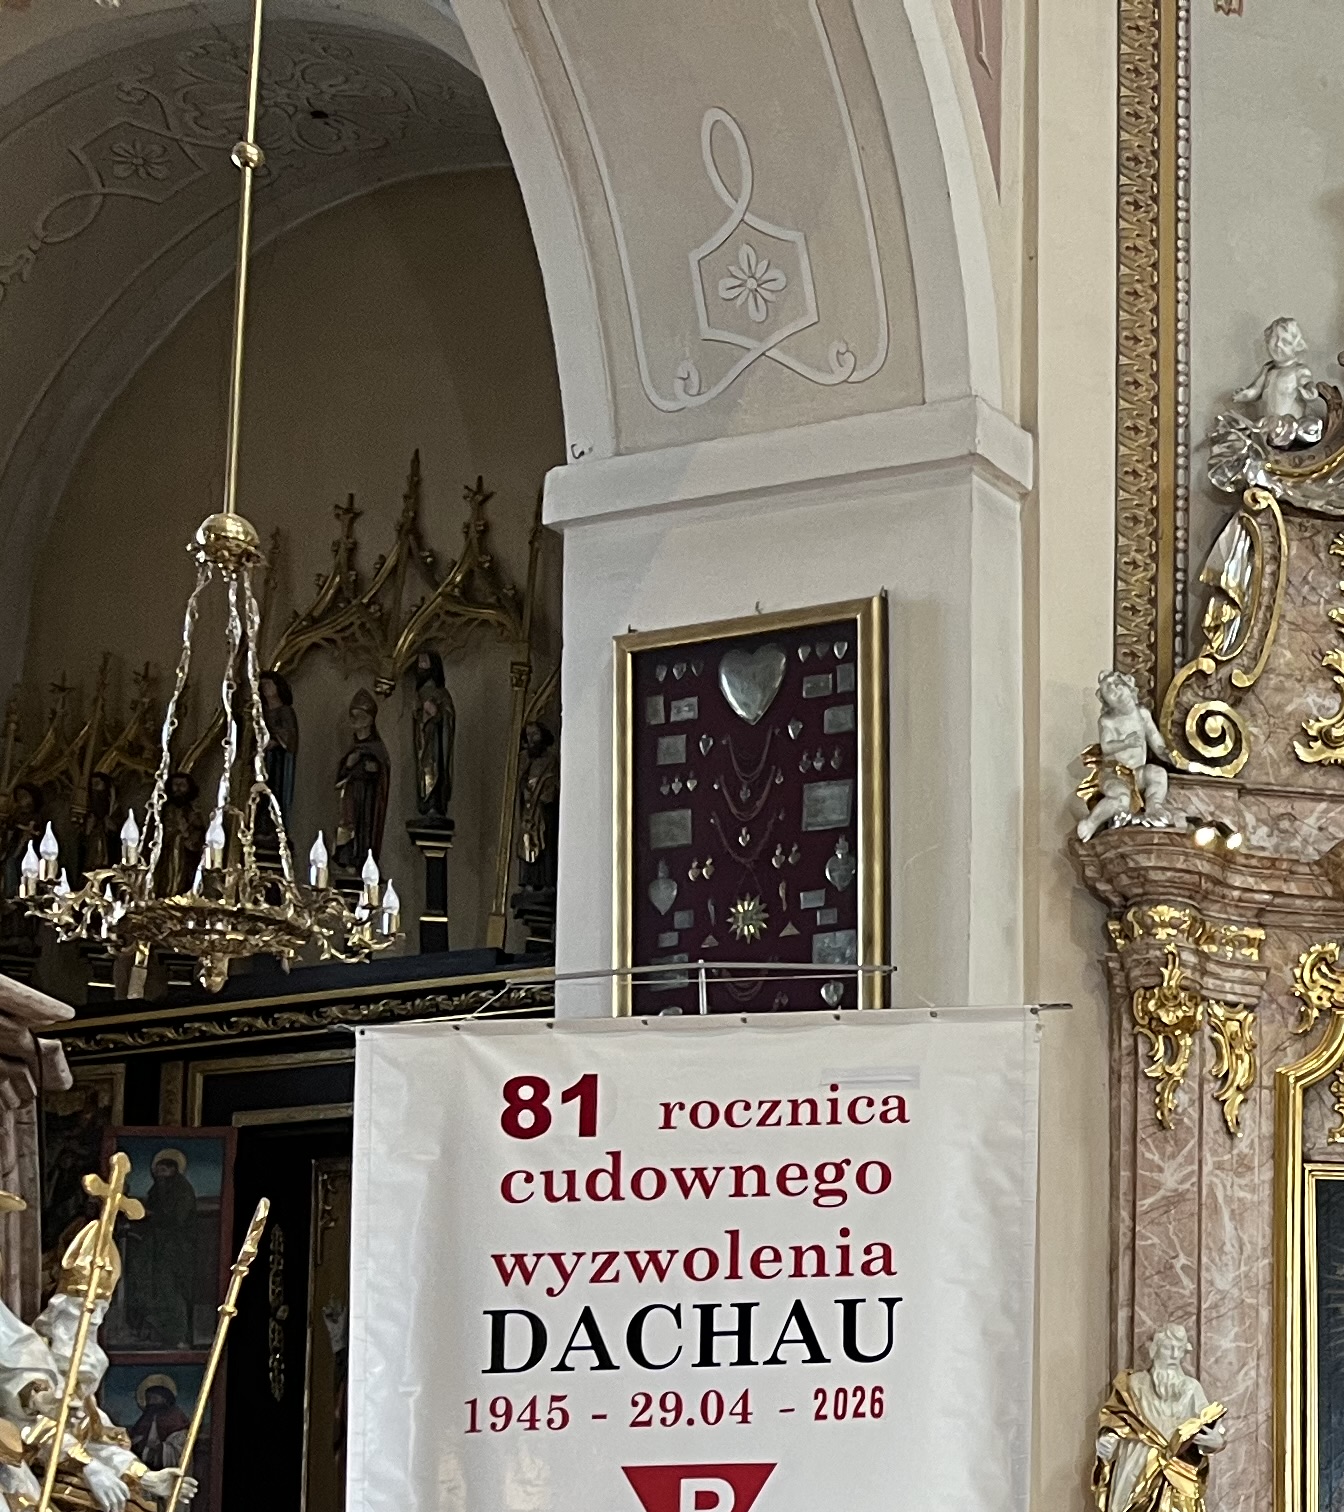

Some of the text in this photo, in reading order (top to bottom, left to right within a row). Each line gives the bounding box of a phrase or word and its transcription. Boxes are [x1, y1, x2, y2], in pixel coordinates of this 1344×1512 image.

[500, 1073, 911, 1140] 81 rocznica
[500, 1150, 893, 1208] cudownego
[490, 1227, 898, 1297] wyzwolenia
[481, 1297, 904, 1374] DACHAU
[464, 1394, 571, 1434] 1945
[628, 1388, 754, 1428] 29.04
[813, 1385, 885, 1421] 2026
